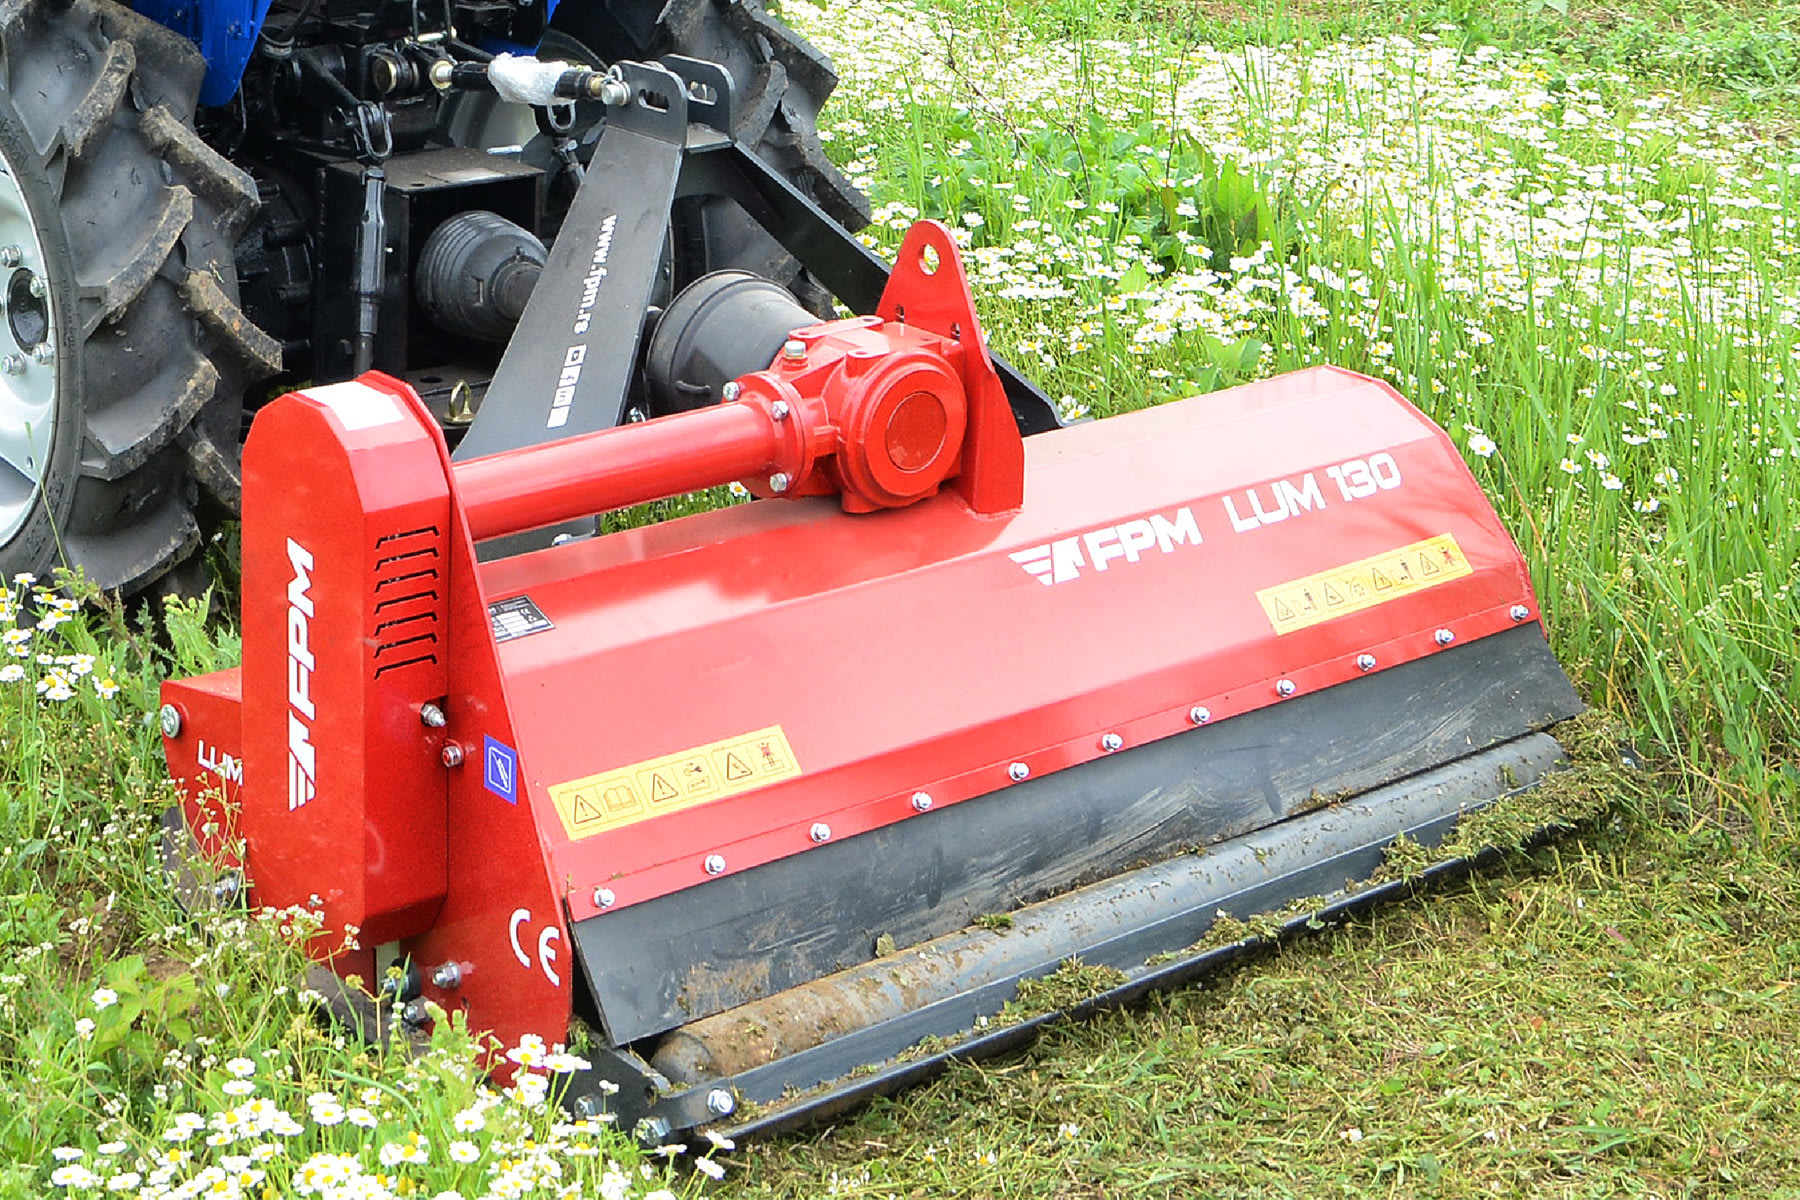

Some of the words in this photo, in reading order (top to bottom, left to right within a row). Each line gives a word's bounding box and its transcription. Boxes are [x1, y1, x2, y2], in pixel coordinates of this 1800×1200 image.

[574, 214, 617, 334] www.fpm.rs
[1083, 507, 1203, 571] FPM
[1223, 473, 1326, 533] LUM
[1326, 453, 1401, 501] 130
[287, 537, 315, 721] FPM
[198, 740, 243, 786] LUM
[510, 908, 560, 987] CE
